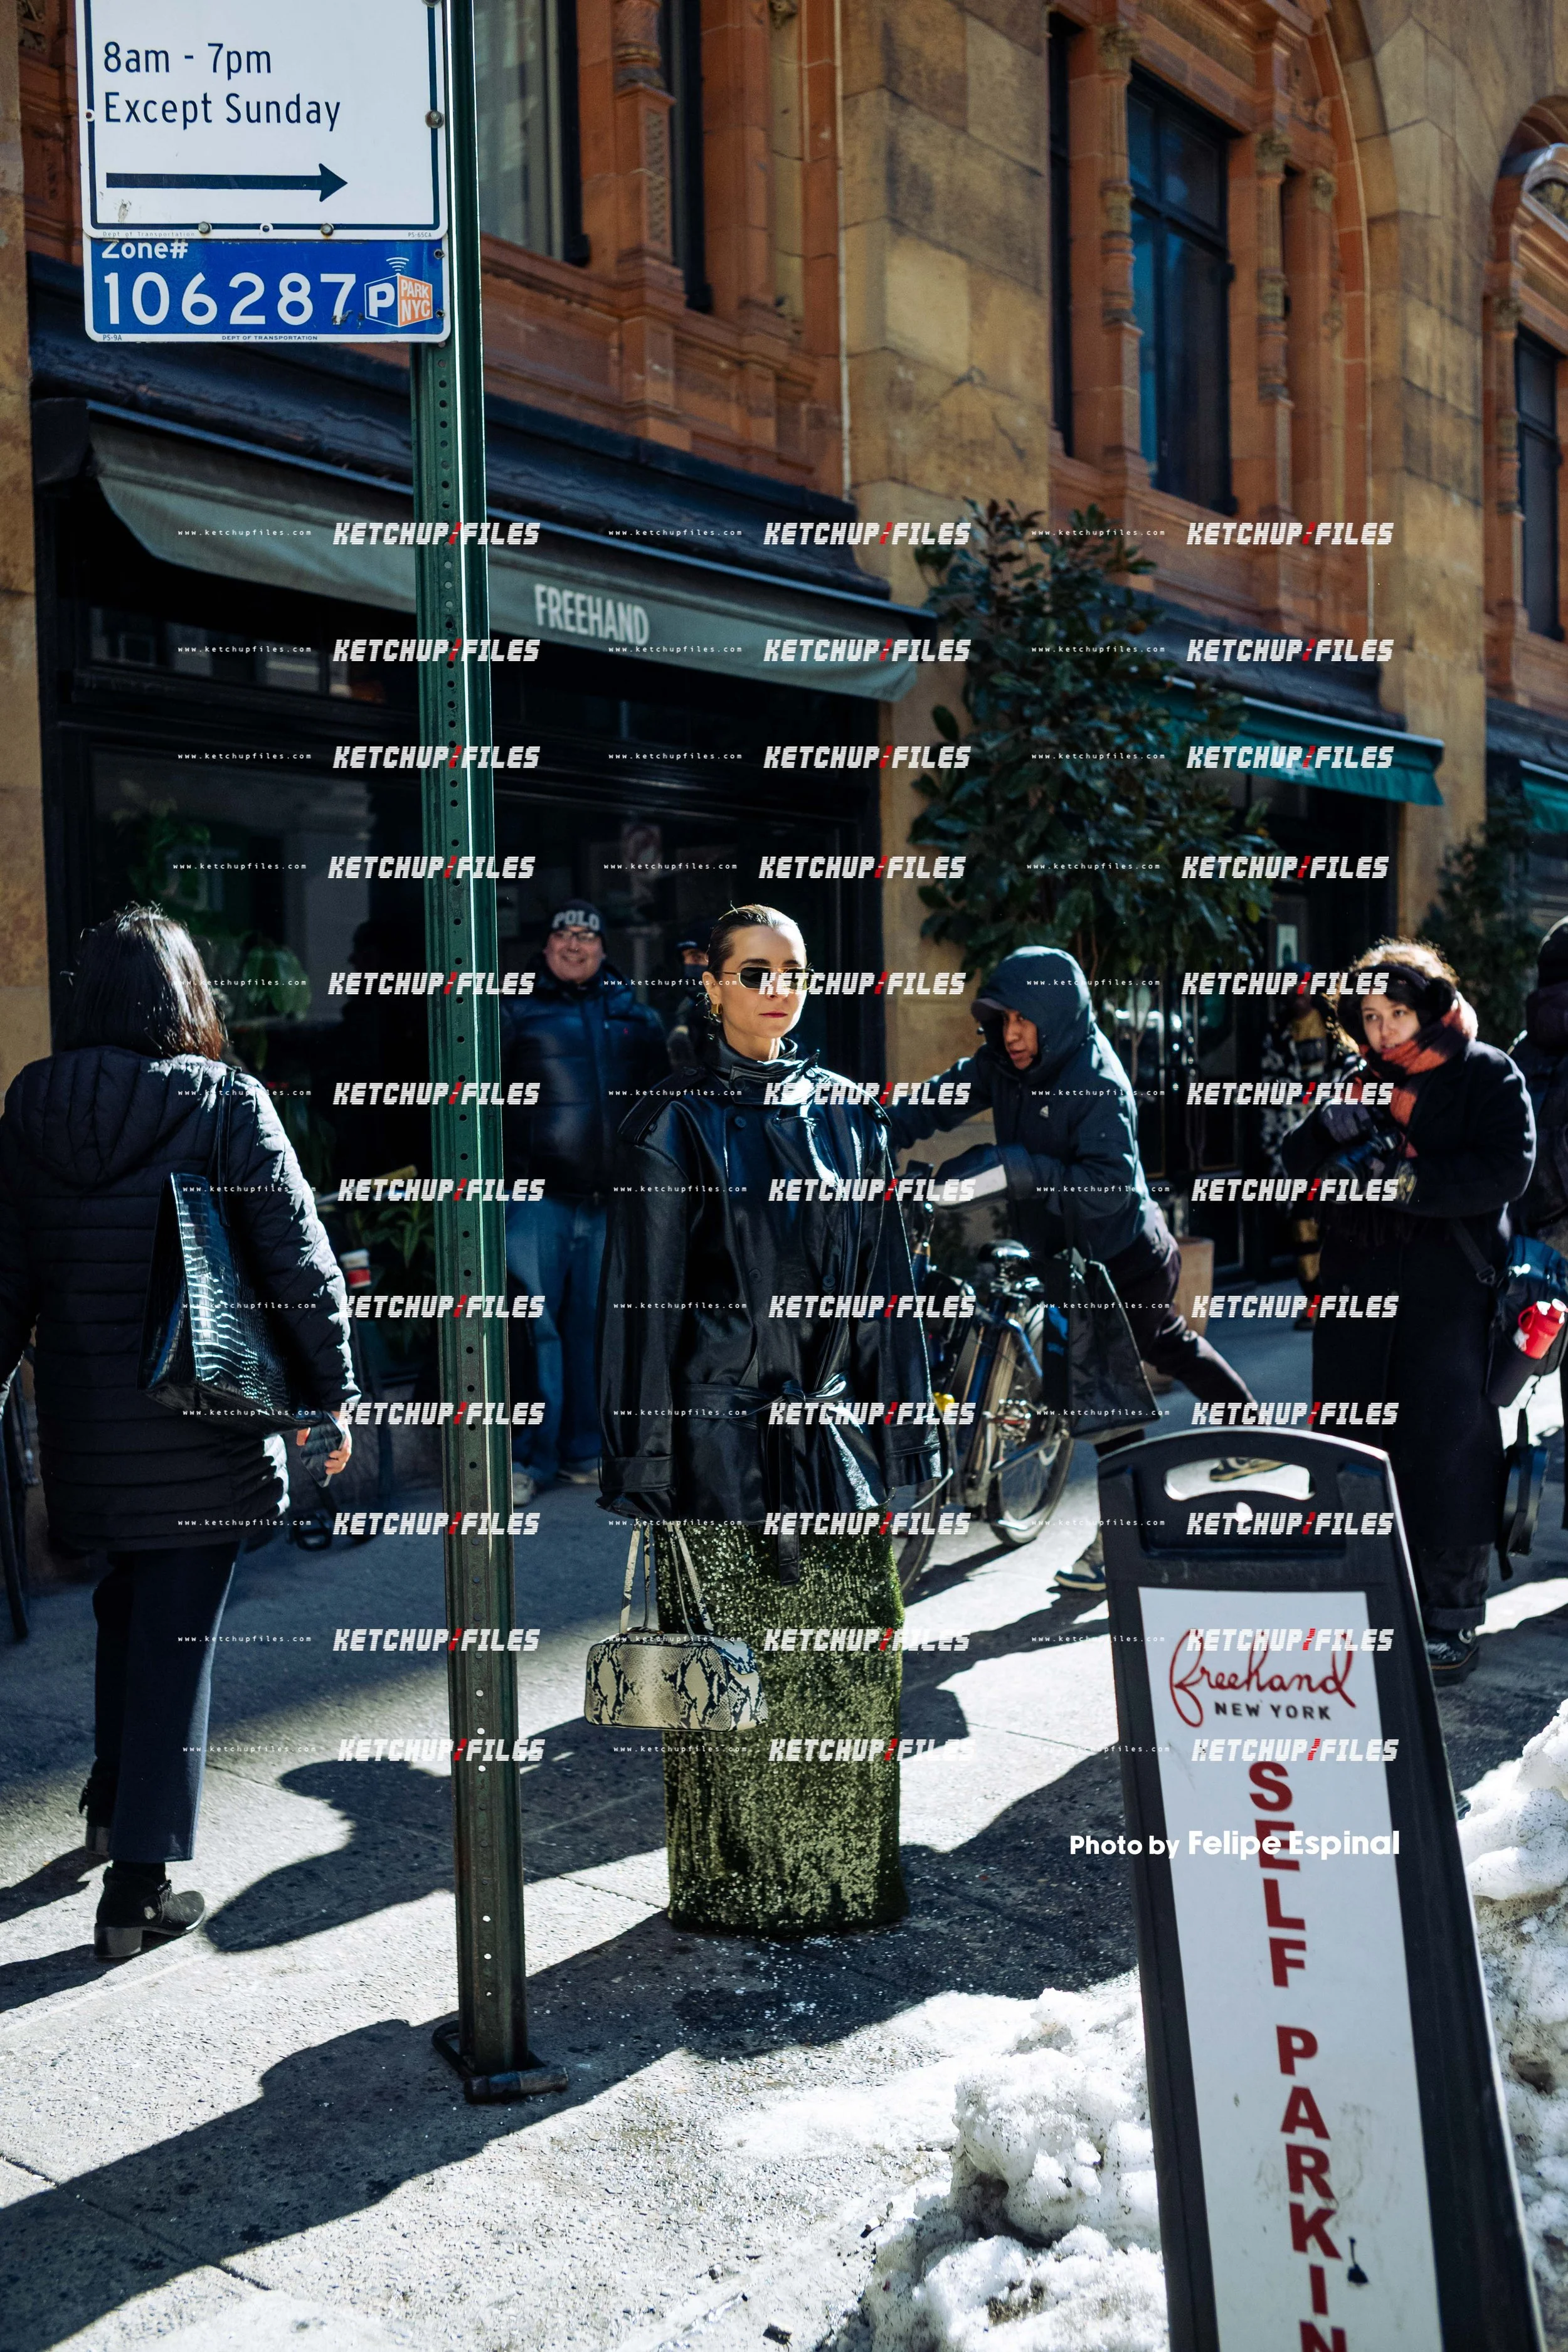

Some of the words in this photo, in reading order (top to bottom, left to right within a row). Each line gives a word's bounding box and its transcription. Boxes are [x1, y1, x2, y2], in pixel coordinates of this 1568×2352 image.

[104, 41, 170, 73] 8am
[208, 43, 272, 80] 7pm
[105, 92, 213, 130] Except
[226, 92, 341, 132] Sunday
[102, 238, 189, 259] Zone#
[104, 272, 356, 326] 106287
[369, 282, 396, 317] P
[400, 280, 430, 299] PARK
[400, 299, 432, 322] NYC
[534, 583, 650, 646] FREEHAND
[1170, 1628, 1357, 1728] freehand
[1214, 1701, 1261, 1718] NEW
[1271, 1703, 1332, 1720] YORK
[1248, 1761, 1307, 1988] SELF
[1276, 2024, 1347, 2352] PARKIN
